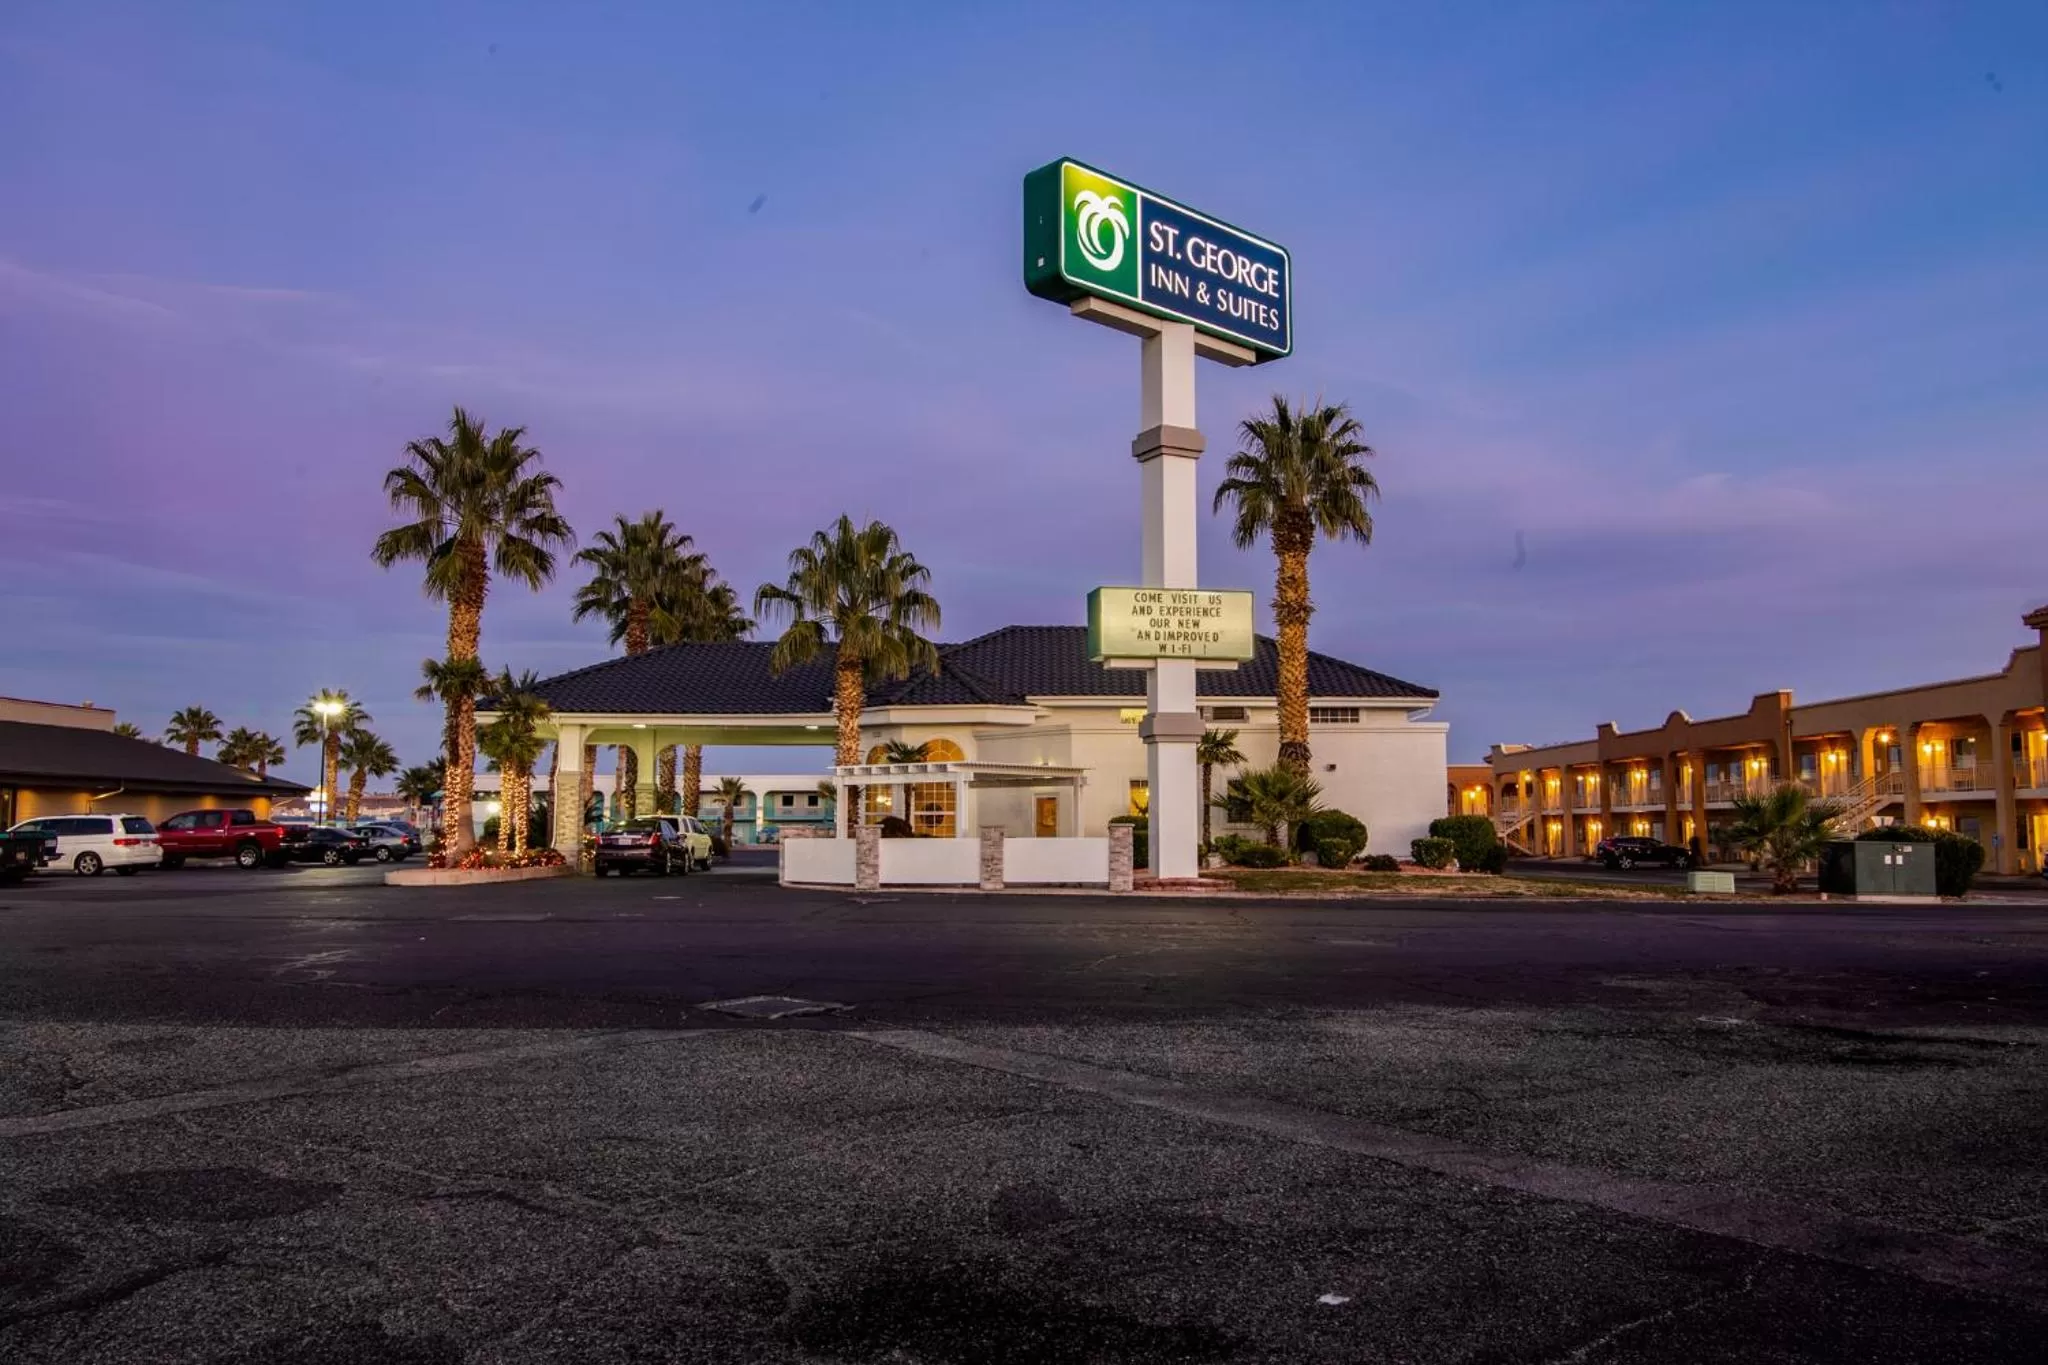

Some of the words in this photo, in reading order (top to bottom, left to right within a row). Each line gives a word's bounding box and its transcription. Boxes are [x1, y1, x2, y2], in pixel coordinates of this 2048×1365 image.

[1150, 221, 1181, 260] ST.
[1187, 236, 1280, 298] GEORGE
[1151, 263, 1189, 298] INN
[1196, 281, 1210, 305] &
[1217, 288, 1279, 331] SUITES
[1134, 592, 1163, 604] COME
[1171, 593, 1198, 605] VISIT
[1208, 595, 1222, 605] US
[1132, 605, 1153, 616] AND
[1159, 605, 1222, 617] EXPERIENCE
[1149, 618, 1170, 629] OUR
[1178, 619, 1201, 629] NEW
